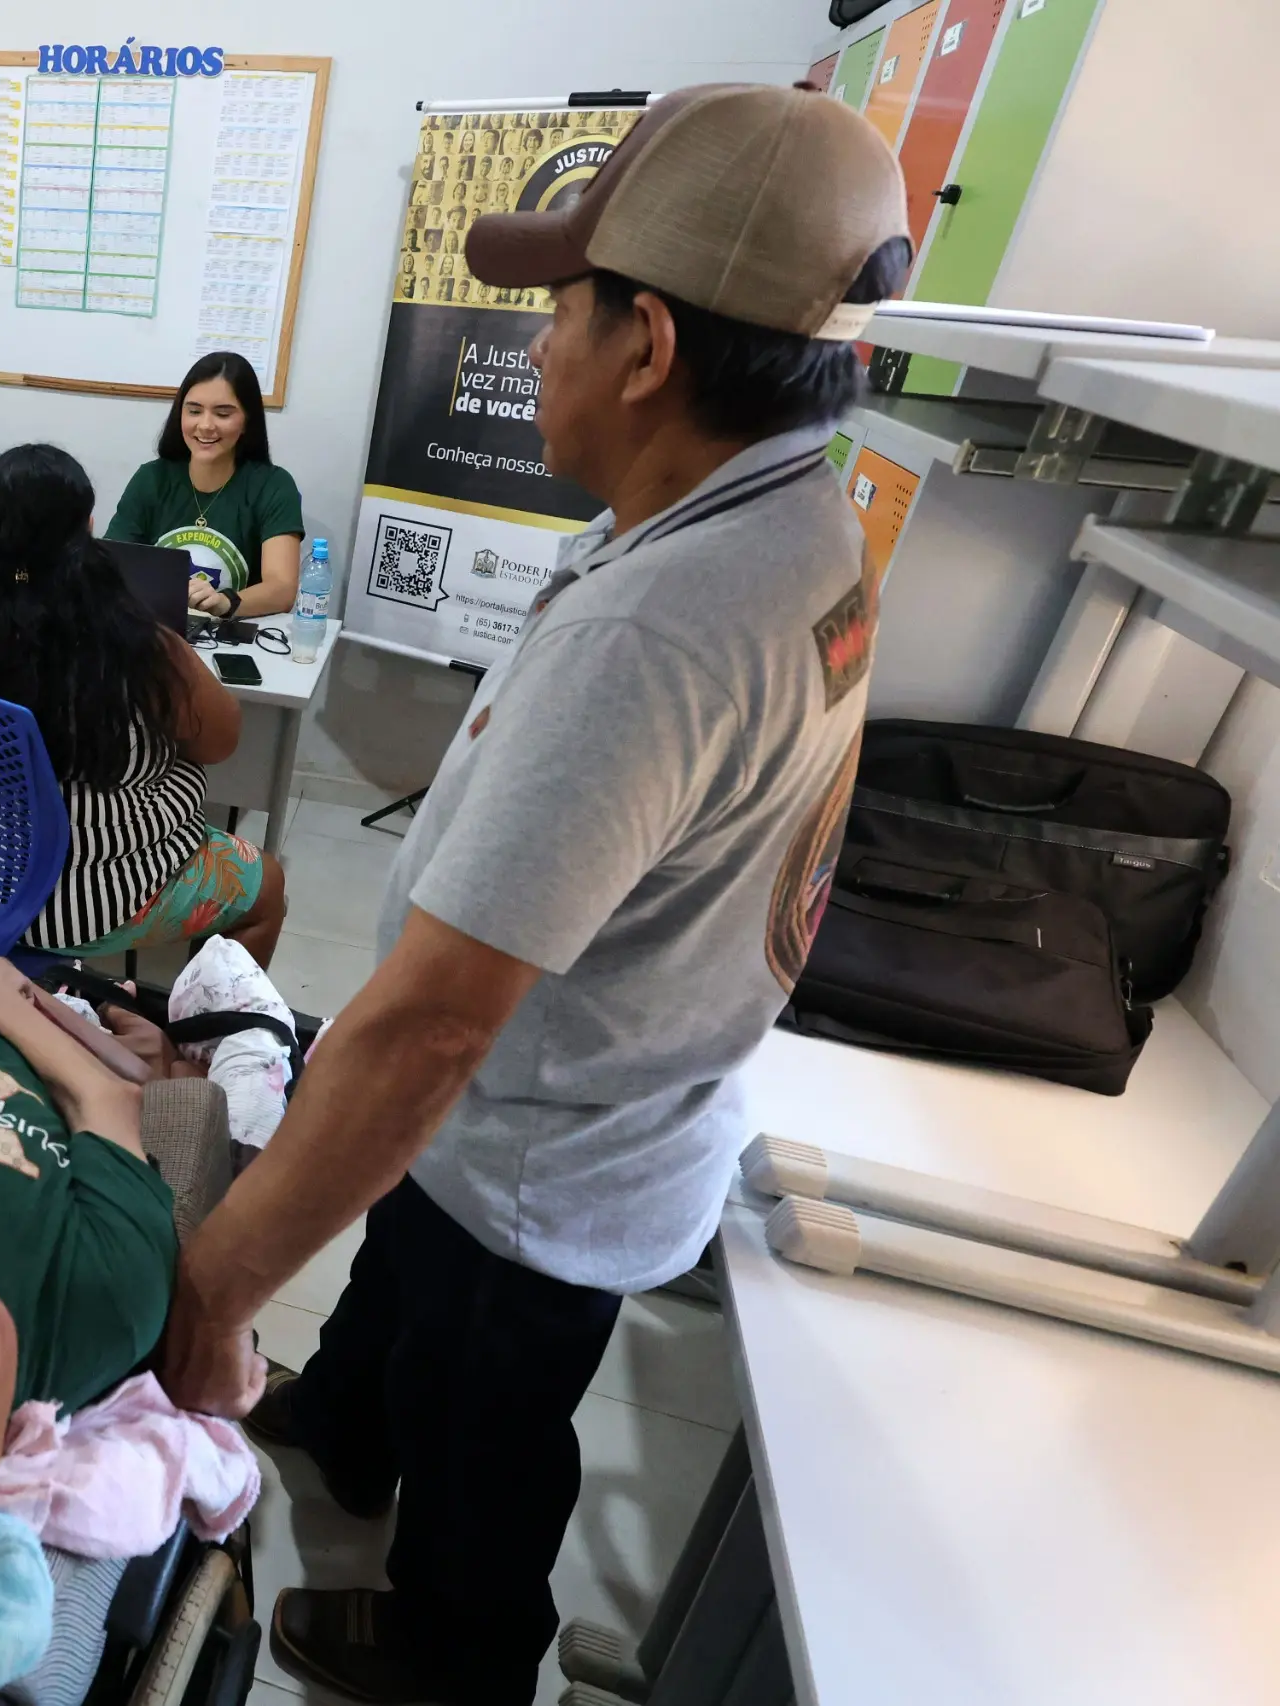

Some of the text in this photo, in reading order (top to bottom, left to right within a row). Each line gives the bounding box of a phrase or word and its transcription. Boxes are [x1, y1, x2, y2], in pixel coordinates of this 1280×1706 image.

[37, 36, 224, 77] HORÁRIOS
[463, 343, 479, 365] A
[461, 371, 544, 396] vez mai
[455, 392, 482, 414] de
[427, 442, 493, 470] Conheça
[176, 532, 221, 549] EXPEDIÇÃO
[501, 558, 540, 577] PODER
[499, 570, 544, 588] ESTADO DE
[476, 617, 520, 635] (65) 3617-3
